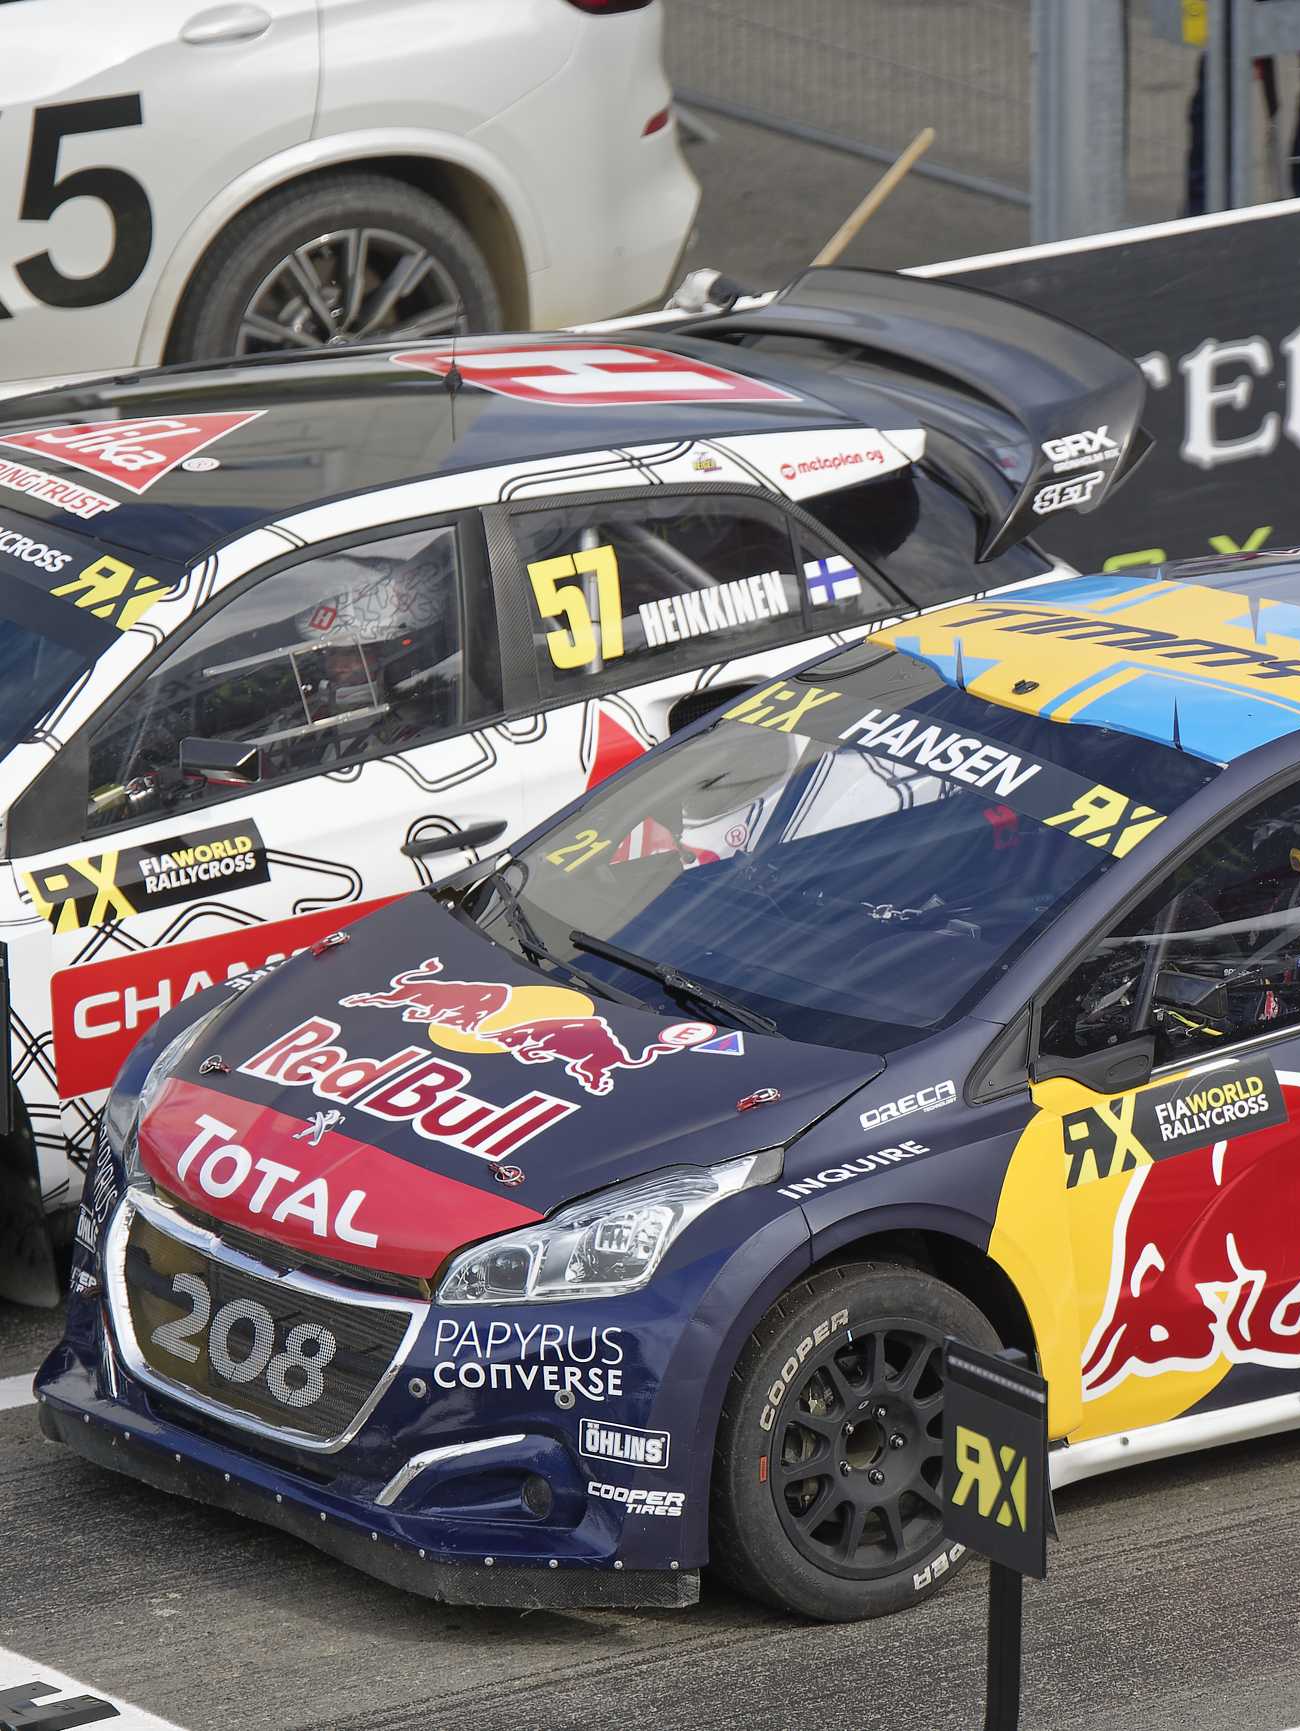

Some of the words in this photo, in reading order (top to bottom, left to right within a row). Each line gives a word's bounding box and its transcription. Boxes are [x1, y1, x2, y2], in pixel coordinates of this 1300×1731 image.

[35, 420, 201, 471] Sika
[798, 451, 863, 474] metaplan
[1041, 425, 1118, 462] GRX
[527, 544, 625, 670] 57
[638, 570, 790, 648] HEIKKINEN
[838, 708, 1042, 798] HANSEN
[144, 852, 256, 894] RALLYCROSS
[545, 829, 612, 873] 21
[860, 1079, 957, 1129] ORECA
[1160, 1094, 1270, 1142] RALLYCROSS
[176, 1114, 379, 1249] TOTAL
[776, 1140, 931, 1200] INQUIRE
[150, 1272, 337, 1408] 208
[433, 1318, 624, 1366] PAPYRUS
[759, 1308, 849, 1432] COOPER
[585, 1422, 666, 1464] ÖHLINS
[587, 1481, 686, 1508] COOPER
[625, 1503, 682, 1517] TIRES
